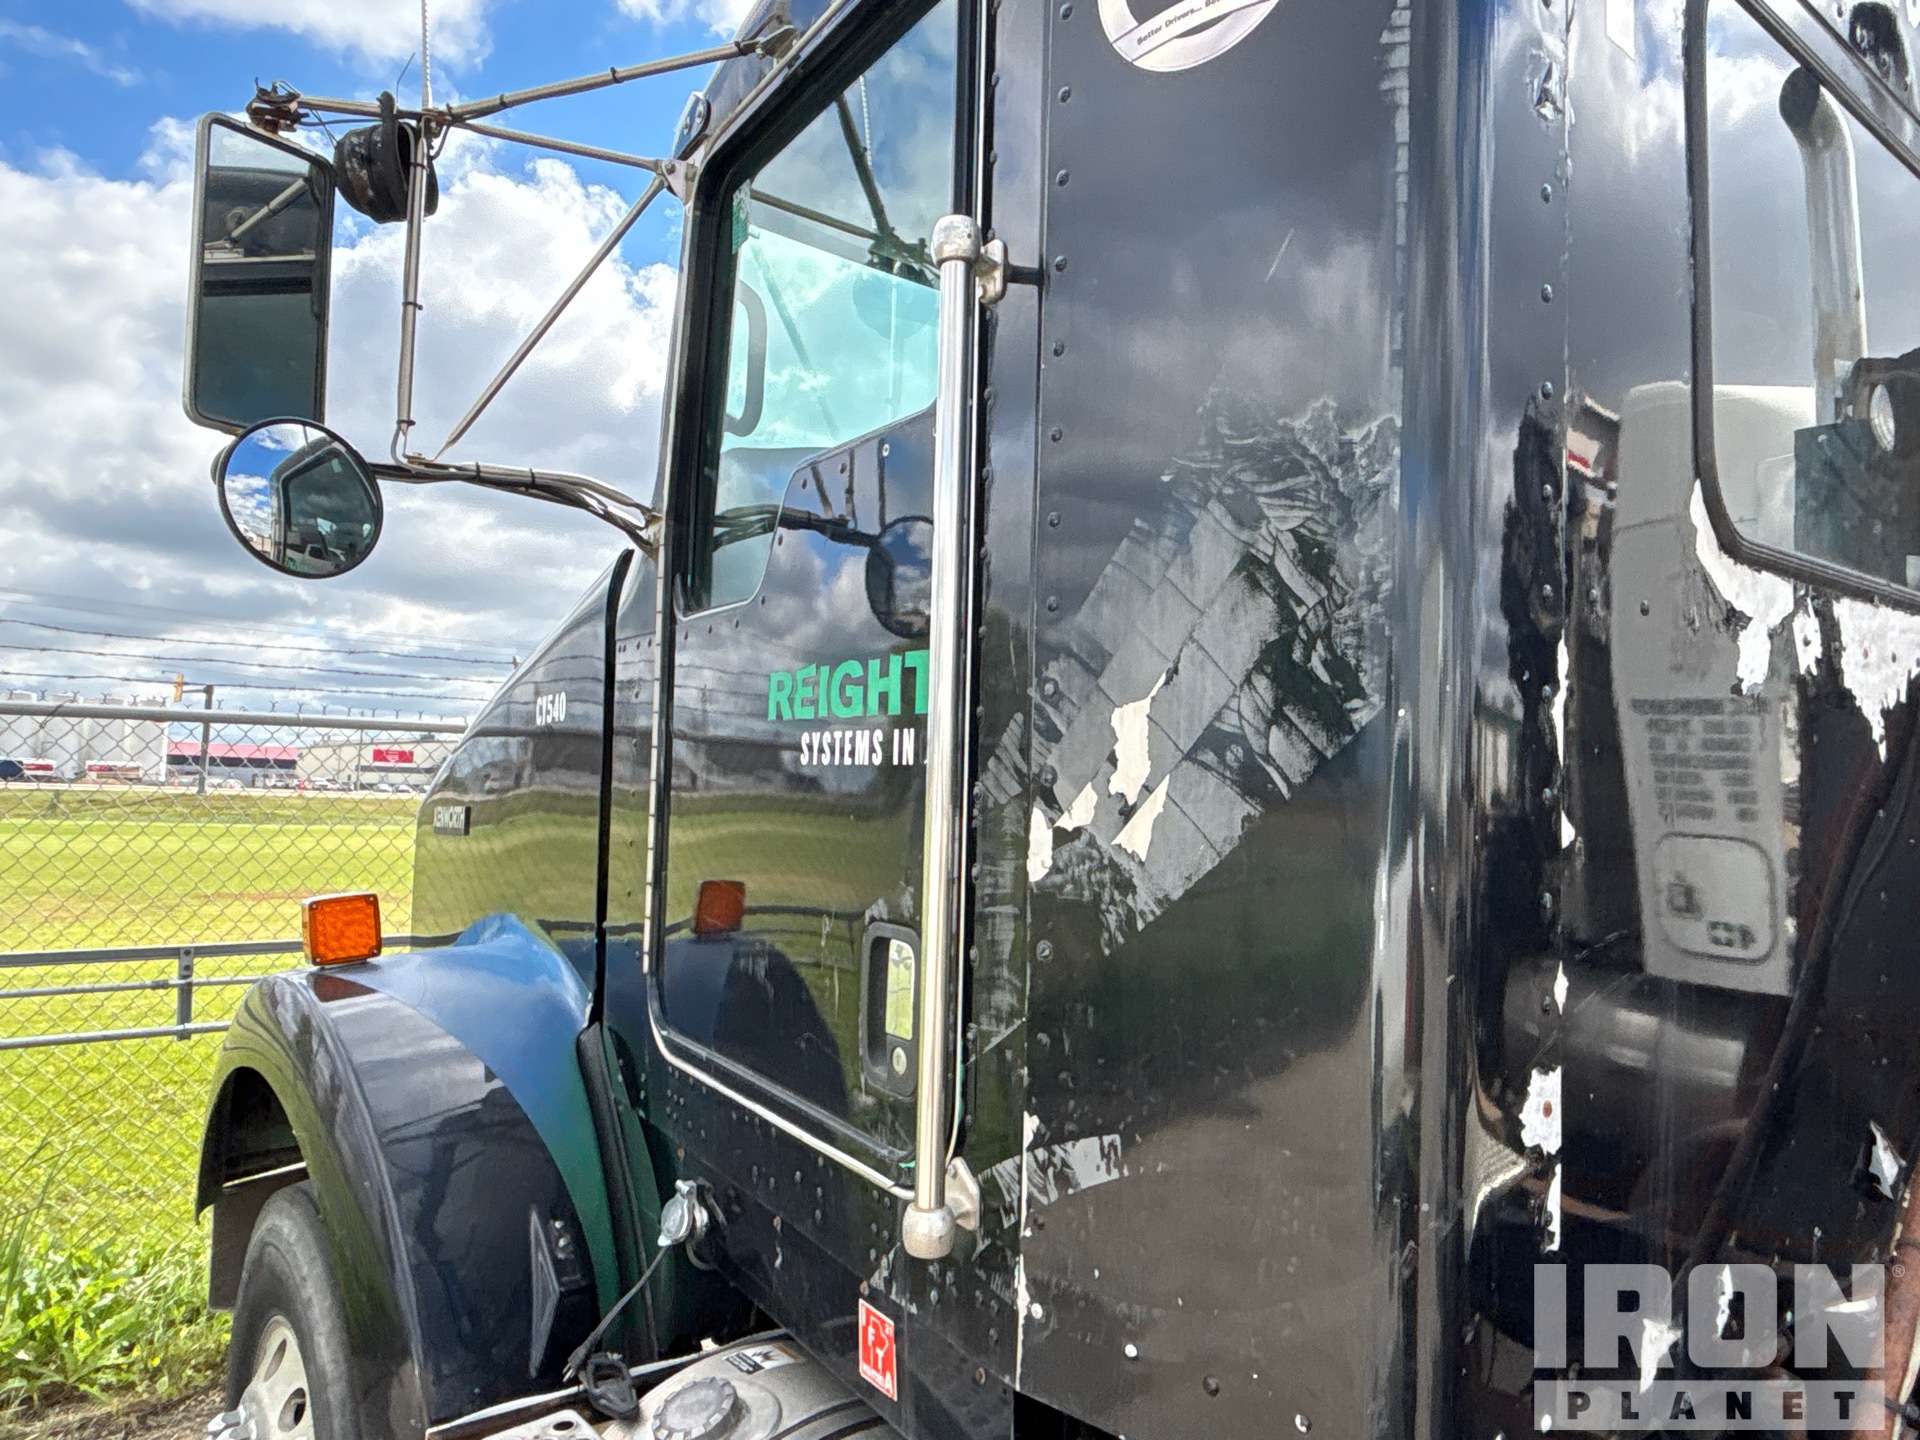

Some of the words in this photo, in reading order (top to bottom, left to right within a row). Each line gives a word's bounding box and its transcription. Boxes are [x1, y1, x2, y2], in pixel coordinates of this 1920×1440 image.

[1137, 25, 1163, 45] Better
[800, 729, 884, 766] SYSTEMS
[892, 727, 916, 766] IN
